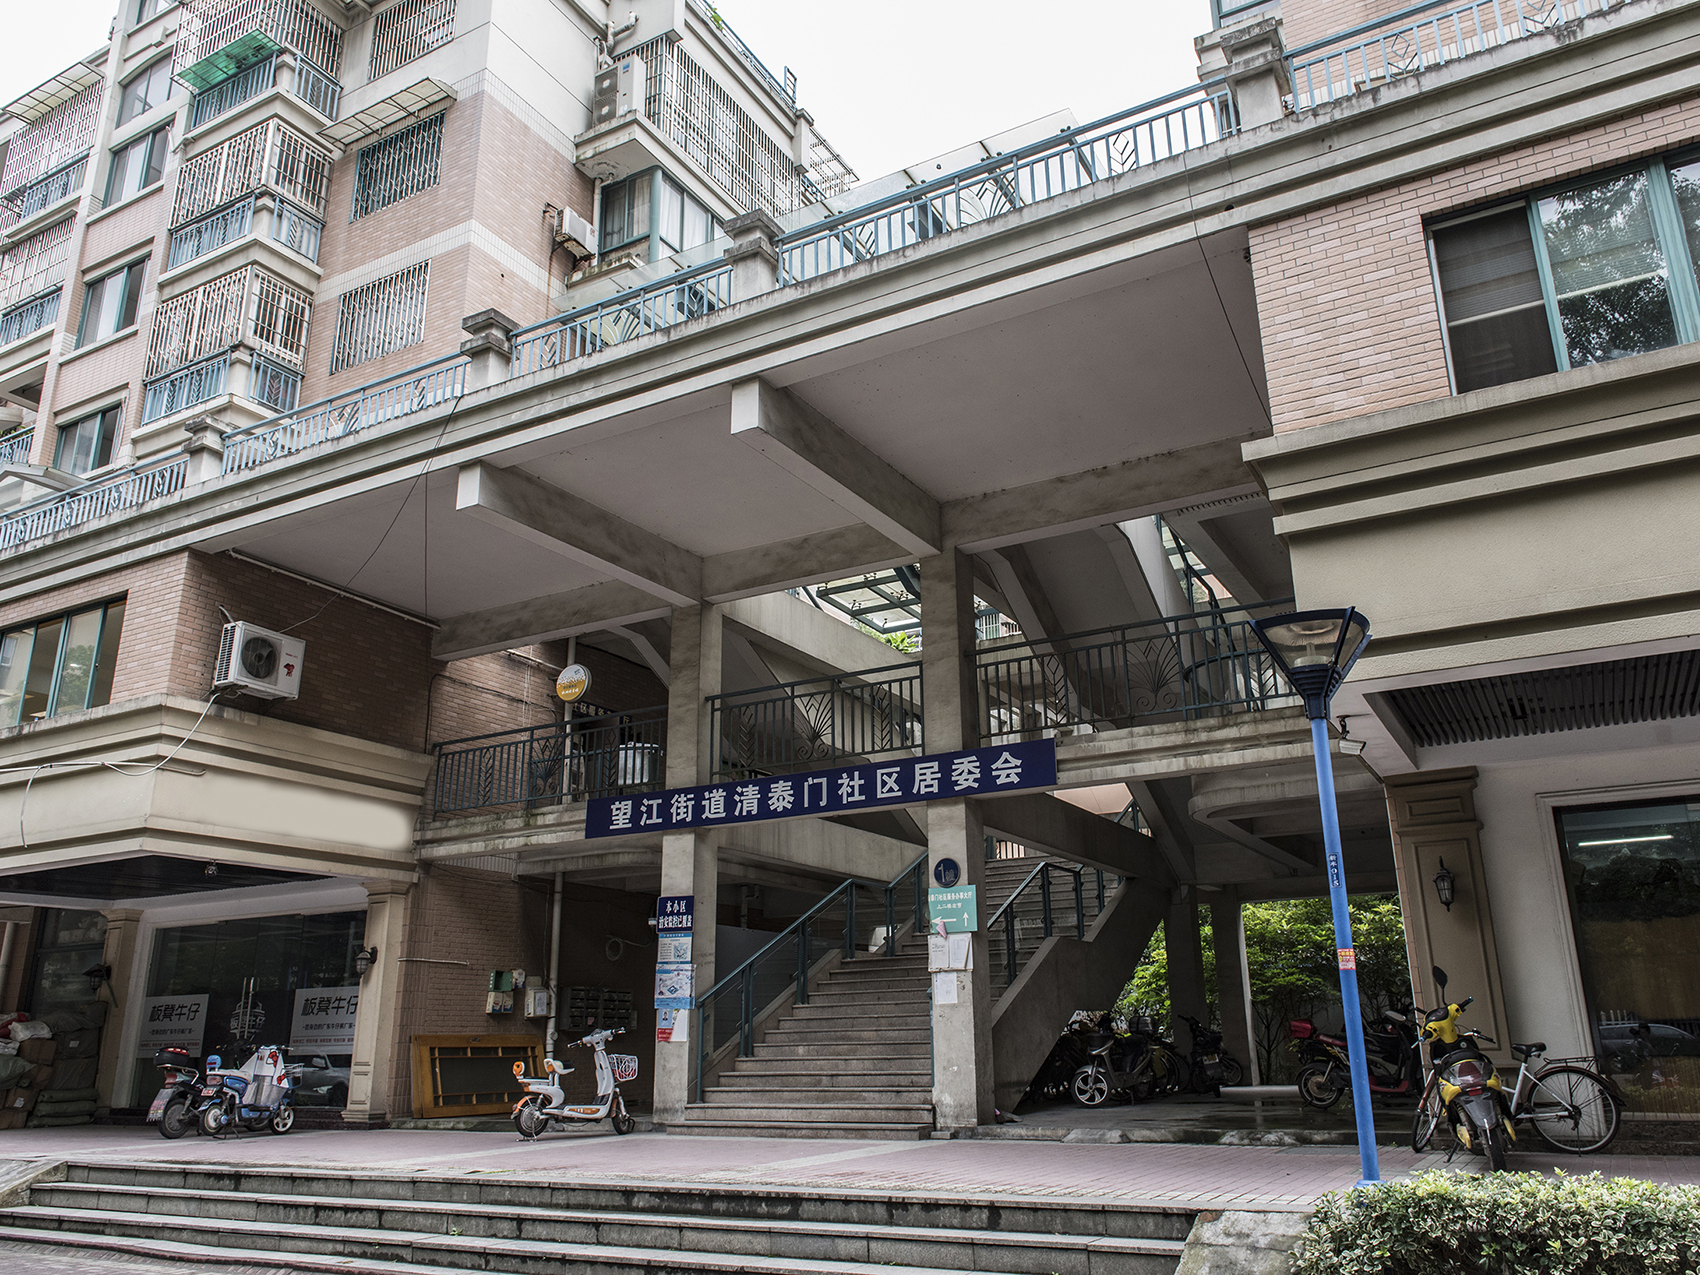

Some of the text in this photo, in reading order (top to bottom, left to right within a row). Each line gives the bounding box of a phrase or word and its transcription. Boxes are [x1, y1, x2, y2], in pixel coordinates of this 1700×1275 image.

[609, 752, 1022, 830] 望江街道清泰门社区居委会
[666, 900, 687, 913] 本小区
[148, 1003, 201, 1022] 板凳牛仔
[301, 995, 359, 1016] 板凳牛仔
